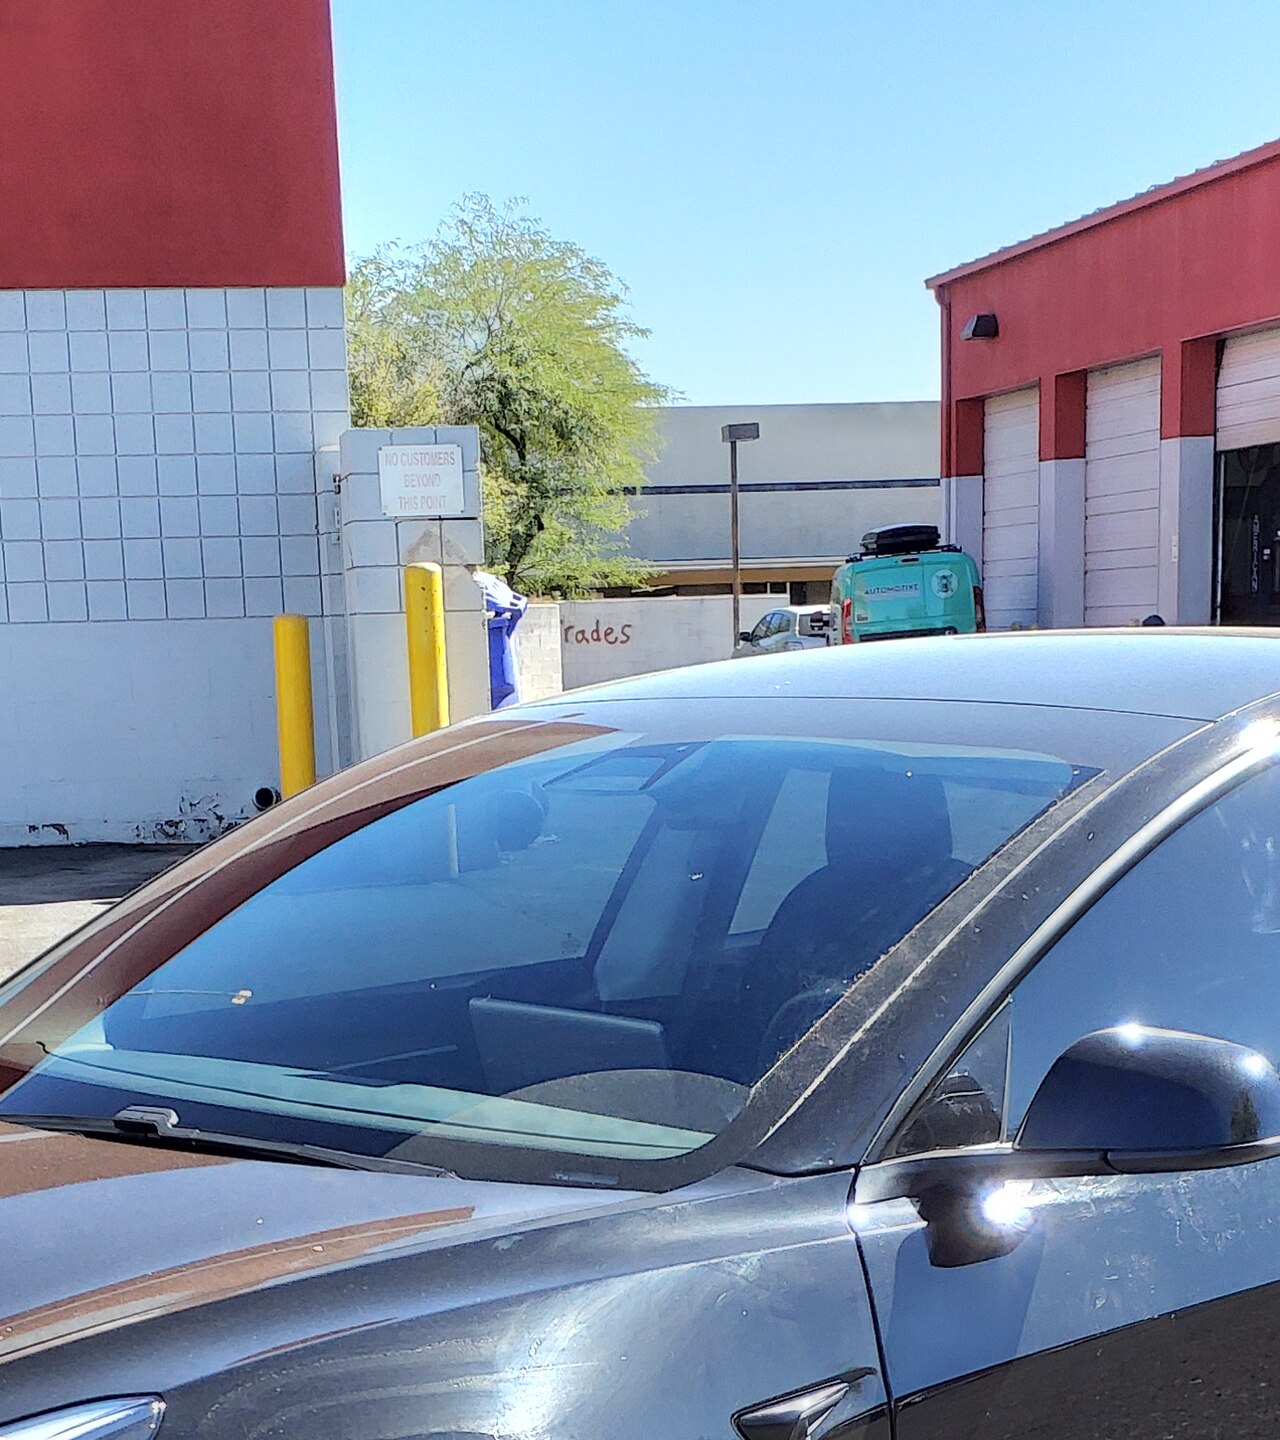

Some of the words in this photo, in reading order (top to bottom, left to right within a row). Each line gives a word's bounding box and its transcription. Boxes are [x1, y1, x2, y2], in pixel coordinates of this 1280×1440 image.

[385, 452, 398, 467] NO
[400, 451, 456, 467] CUSTOMERS
[403, 472, 441, 488] BEYOND
[398, 495, 419, 510] THIS
[420, 495, 447, 510] POINT
[864, 583, 919, 596] AUTOMOTIVE
[562, 618, 632, 645] rades
